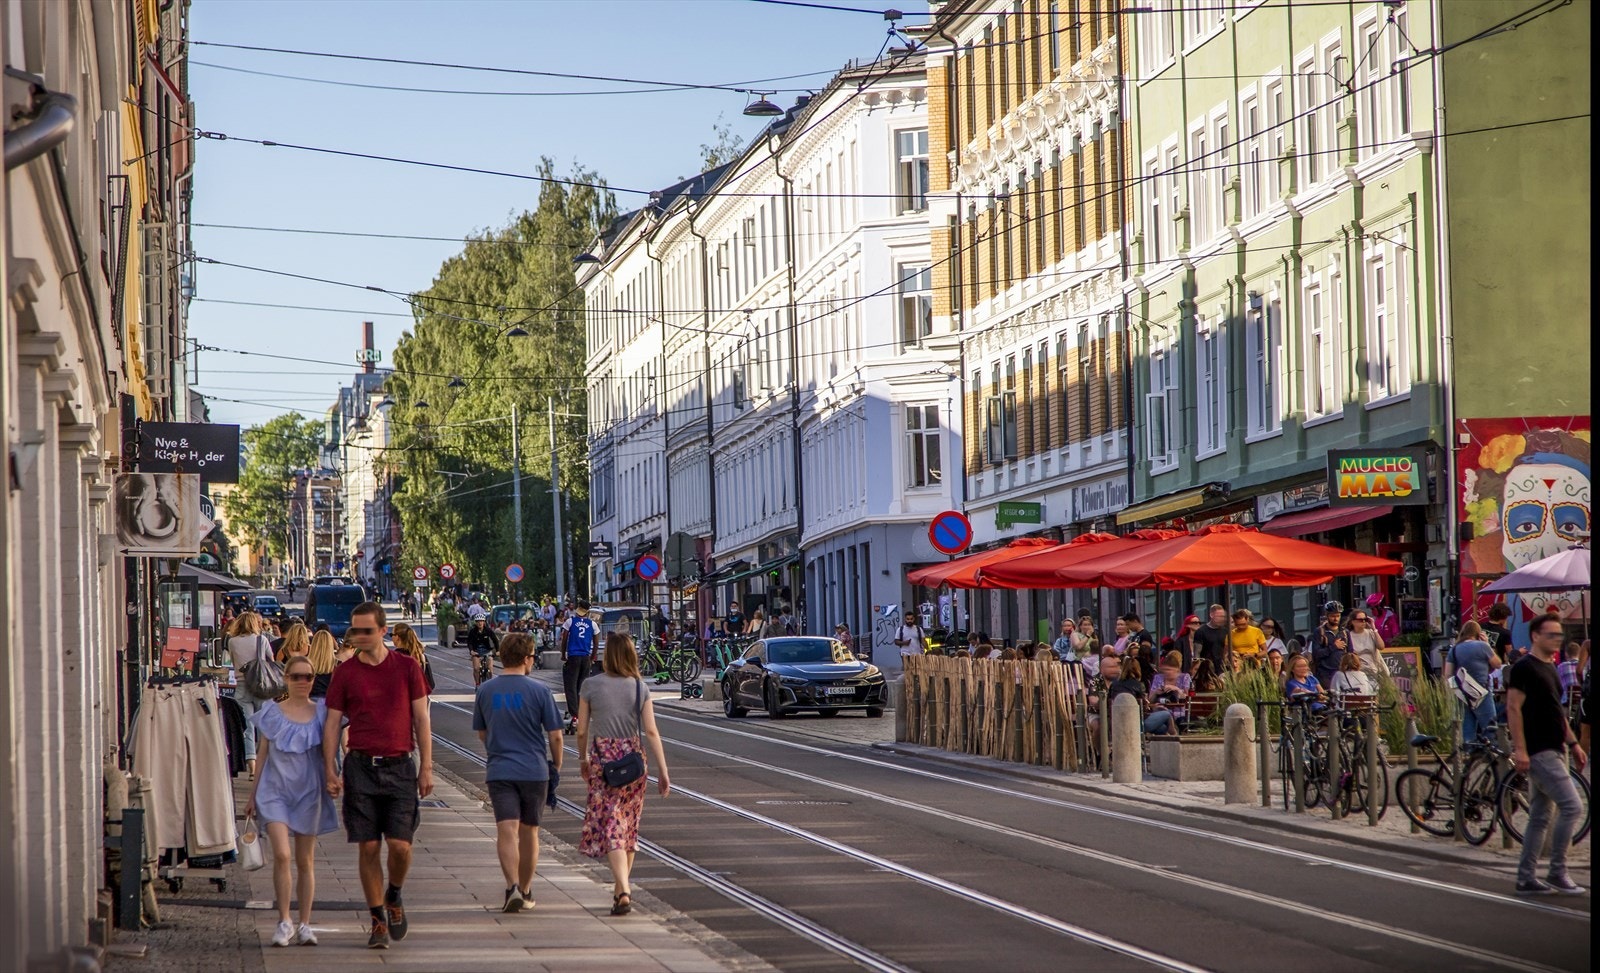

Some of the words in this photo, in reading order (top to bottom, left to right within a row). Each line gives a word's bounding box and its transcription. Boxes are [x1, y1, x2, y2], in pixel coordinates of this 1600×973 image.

[155, 437, 177, 449] Nye
[180, 438, 189, 448] &
[1341, 457, 1411, 472] MUCHO
[1339, 473, 1412, 498] MAS
[1081, 485, 1104, 513] Velouria
[1106, 481, 1127, 507] Vintage
[578, 626, 586, 638] 2
[1384, 656, 1398, 666] Try
